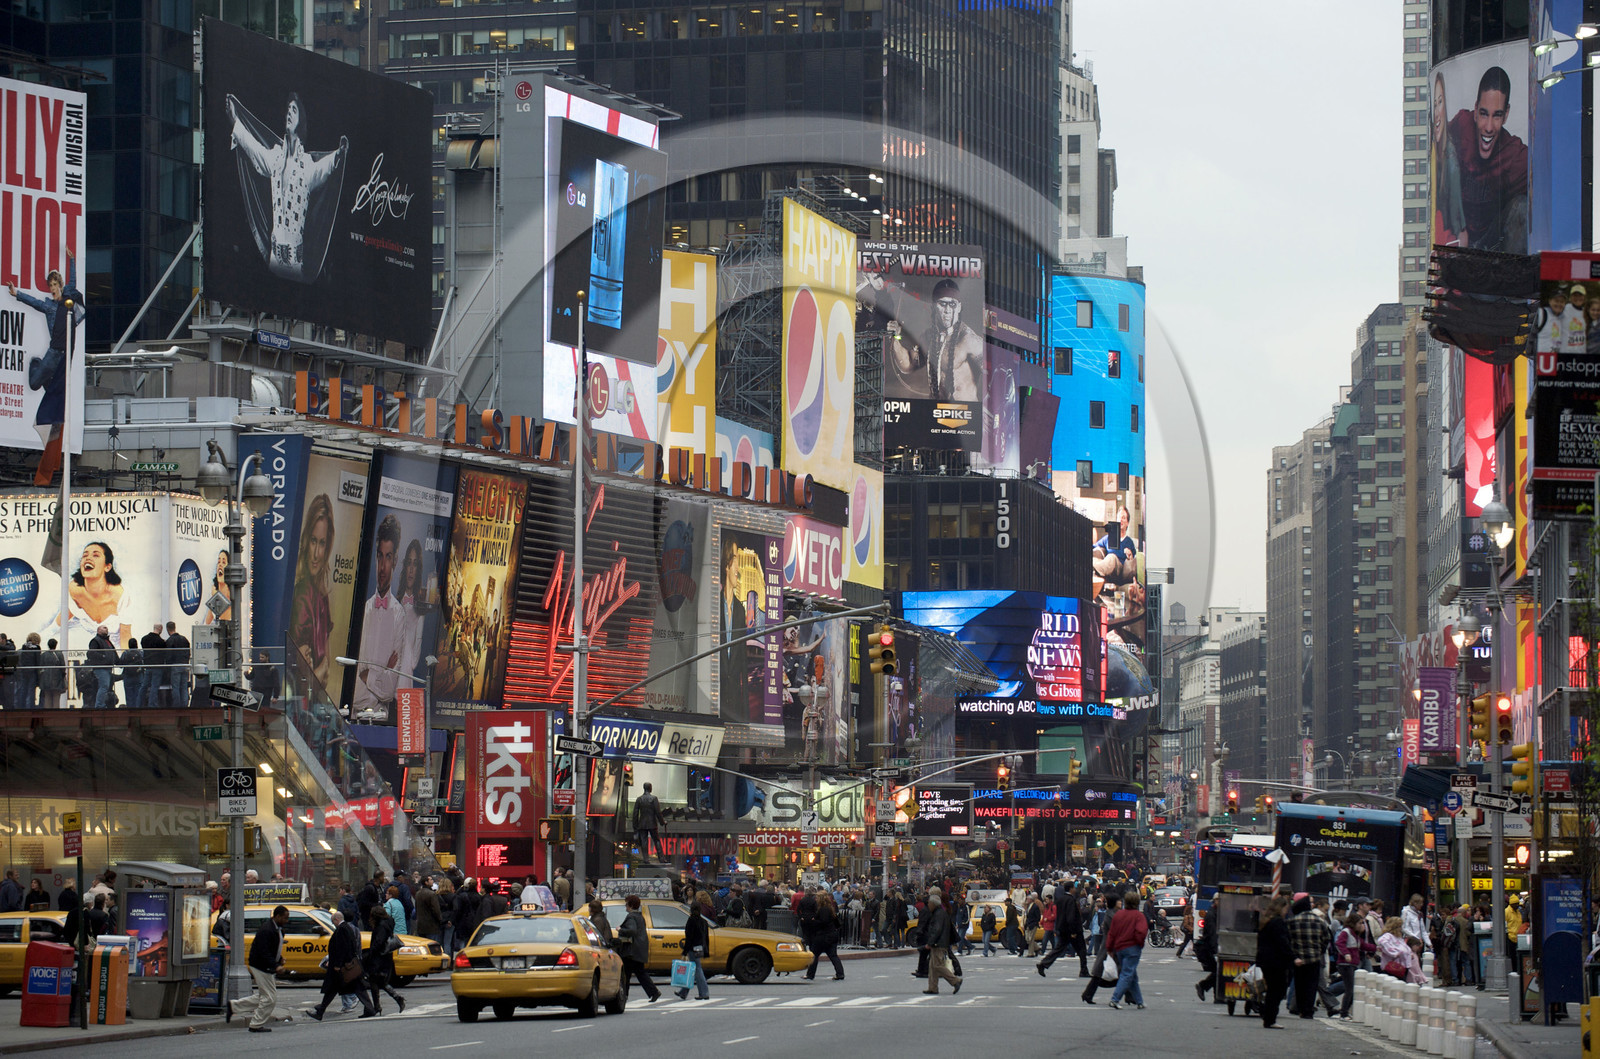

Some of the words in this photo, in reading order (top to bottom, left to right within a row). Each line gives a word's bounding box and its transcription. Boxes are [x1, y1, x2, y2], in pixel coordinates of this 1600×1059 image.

[516, 103, 531, 113] LG
[66, 103, 84, 167] MUSICAL
[66, 170, 82, 195] THE
[577, 191, 586, 208] LG
[788, 202, 855, 295] HAPPY
[864, 242, 886, 250] WHO
[900, 253, 981, 278] WARRIOR
[259, 332, 272, 343] Van
[273, 334, 290, 348] Wagner
[5, 397, 23, 408] Street
[609, 377, 634, 414] LG
[895, 414, 901, 423] 7
[932, 409, 973, 420] SPIKE
[1560, 414, 1572, 422] EIF
[296, 370, 619, 471] BERTELSMAN
[643, 441, 814, 509] BUILDING
[136, 463, 176, 471] LAMAR
[97, 498, 159, 515] MUSICAL
[271, 438, 287, 561] VORNADO
[463, 474, 527, 526] HEIGHTS
[191, 506, 222, 525] WORLD’S
[997, 482, 1010, 549] 1500
[13, 519, 22, 533] A
[176, 521, 209, 538] POPULAR
[479, 524, 492, 538] TONY
[493, 526, 511, 541] AWARD
[463, 538, 480, 563] BEST
[480, 540, 508, 567] MUSICAL
[334, 554, 354, 570] Head
[333, 566, 353, 584] Case
[768, 574, 779, 585] BOOK
[1032, 643, 1082, 672] NEWS
[1044, 673, 1055, 681] with
[216, 689, 231, 698] ONE
[236, 692, 253, 704] WAY
[1128, 695, 1150, 712] JVC
[960, 701, 1015, 714] watching
[1017, 701, 1036, 713] ABC
[1036, 702, 1056, 714] News
[1058, 703, 1083, 715] with
[402, 693, 411, 752] BIENVENIDOS
[1423, 689, 1439, 747] KARIBU
[195, 731, 201, 740] W
[203, 731, 212, 740] 47
[591, 724, 659, 752] VORNADO
[668, 731, 713, 756] Retail
[563, 741, 577, 750] ONE
[583, 744, 597, 752] WAY
[1407, 724, 1418, 764] COME
[485, 721, 533, 825] tkts
[919, 791, 941, 799] LOVE
[919, 799, 949, 807] spending
[1479, 796, 1493, 805] ONE
[1500, 799, 1513, 808] WAY
[919, 812, 946, 820] together
[1058, 808, 1072, 818] OF
[1332, 821, 1347, 830] 851
[680, 837, 738, 856] HOLLYWOOD
[739, 832, 788, 845] swatch
[1290, 834, 1301, 846] hp
[1305, 837, 1326, 847] Touch
[1326, 839, 1338, 847] the
[1339, 840, 1361, 850] future
[274, 887, 300, 895] AVENUE
[31, 968, 57, 979] VOICE
[98, 996, 106, 1020] metro
